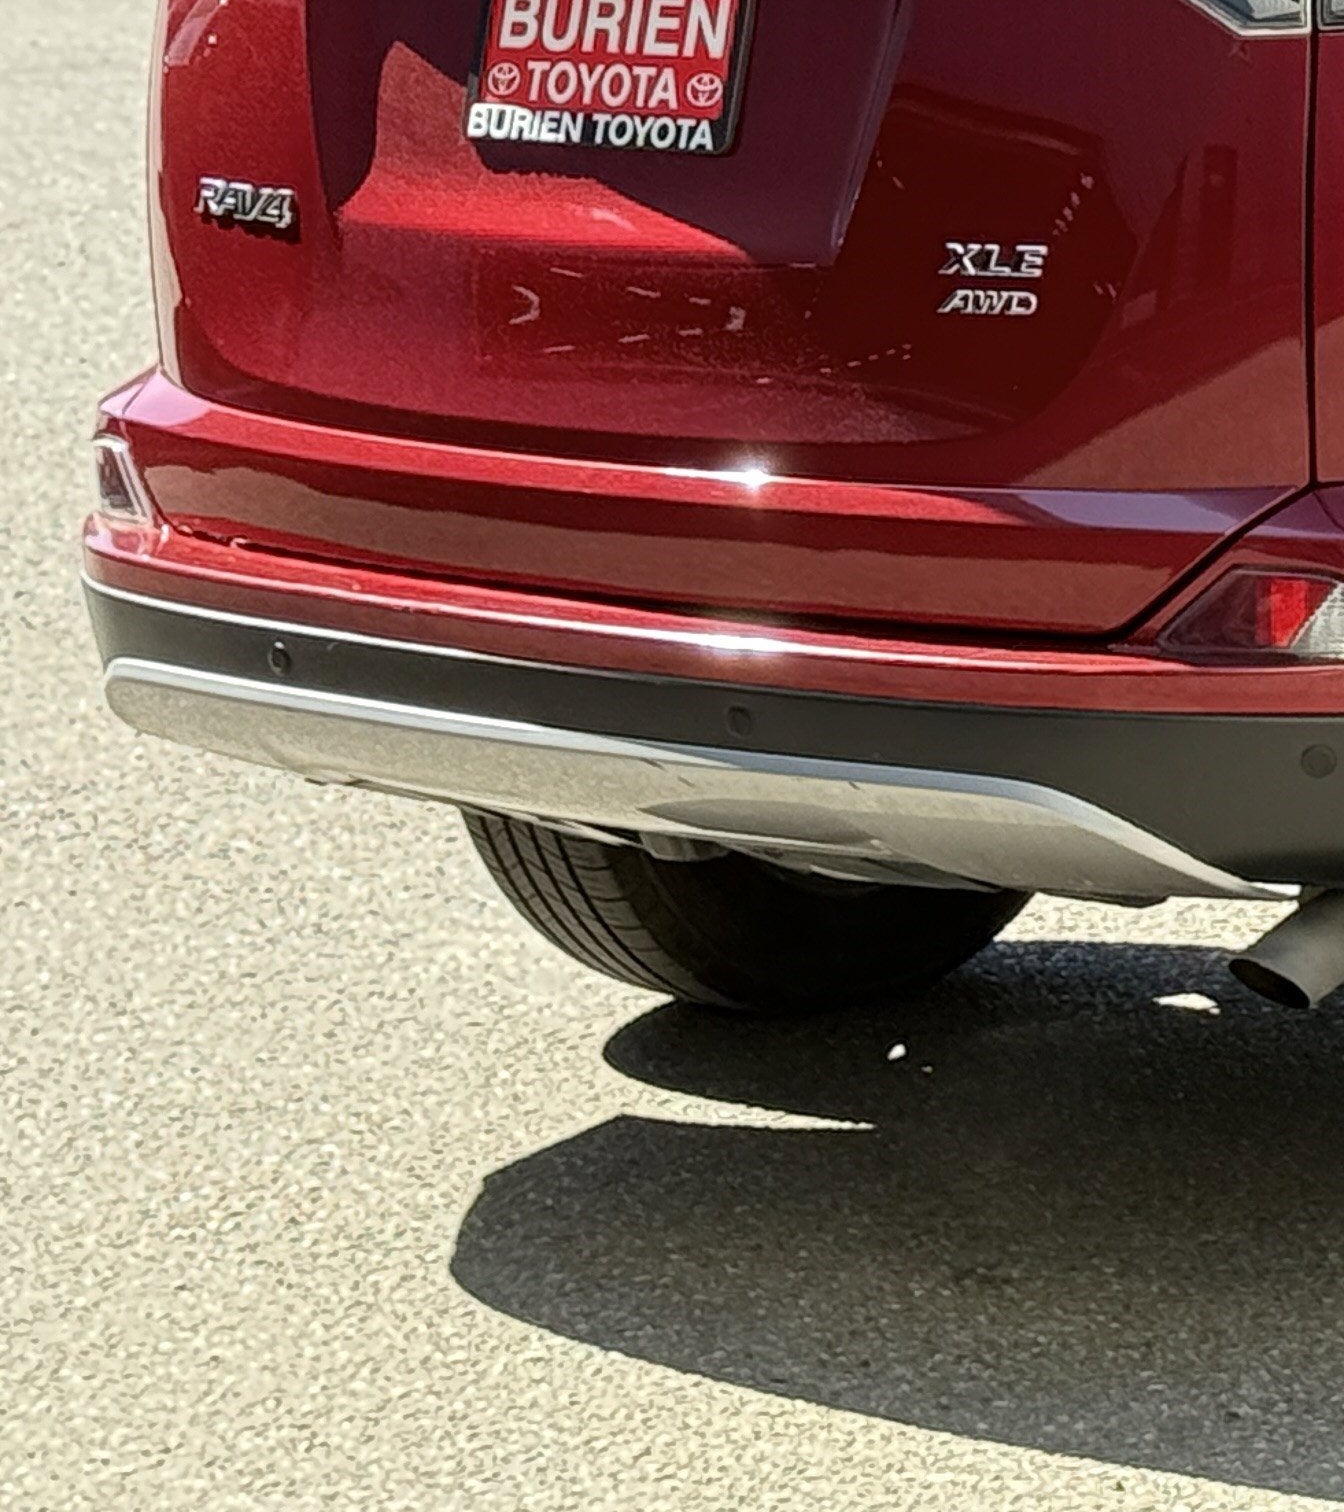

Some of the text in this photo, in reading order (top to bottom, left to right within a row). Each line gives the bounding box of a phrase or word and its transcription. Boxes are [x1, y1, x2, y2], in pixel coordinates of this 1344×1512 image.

[526, 60, 679, 111] TOYOTA
[466, 102, 715, 152] BURIEN TOYOTA
[192, 175, 296, 229] RAV4
[937, 241, 1049, 278] XLE
[936, 288, 1038, 316] AWD
